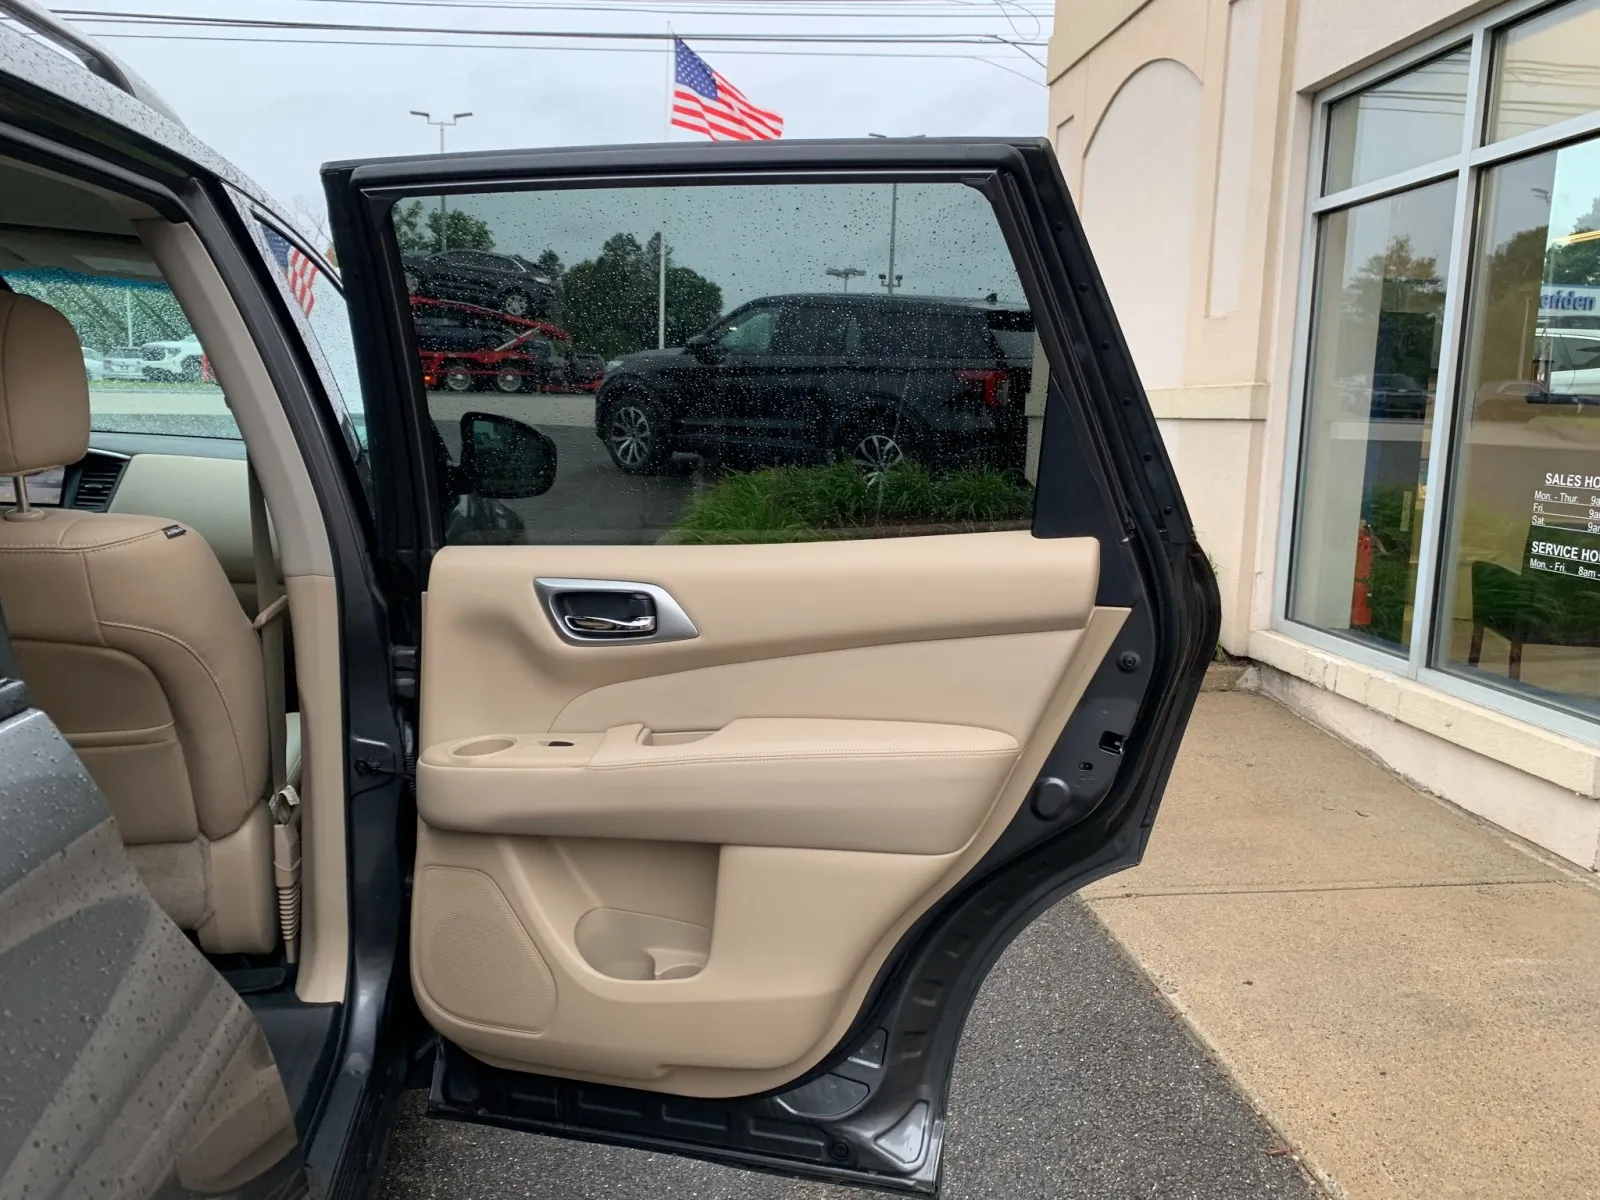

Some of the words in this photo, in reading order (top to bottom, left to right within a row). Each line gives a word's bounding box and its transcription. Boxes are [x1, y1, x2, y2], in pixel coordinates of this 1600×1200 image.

[1545, 472, 1582, 487] SALES
[1534, 490, 1553, 501] Mon.
[1560, 492, 1579, 504] Thur.
[1532, 502, 1545, 513] Fri.
[1588, 508, 1600, 519] 9a
[1531, 515, 1546, 526] Sat.
[1531, 541, 1579, 559] SERVICE
[1581, 548, 1600, 562] HO
[1529, 558, 1547, 570] Mon.
[1554, 562, 1567, 573] Fri.
[1578, 566, 1596, 578] 8am
